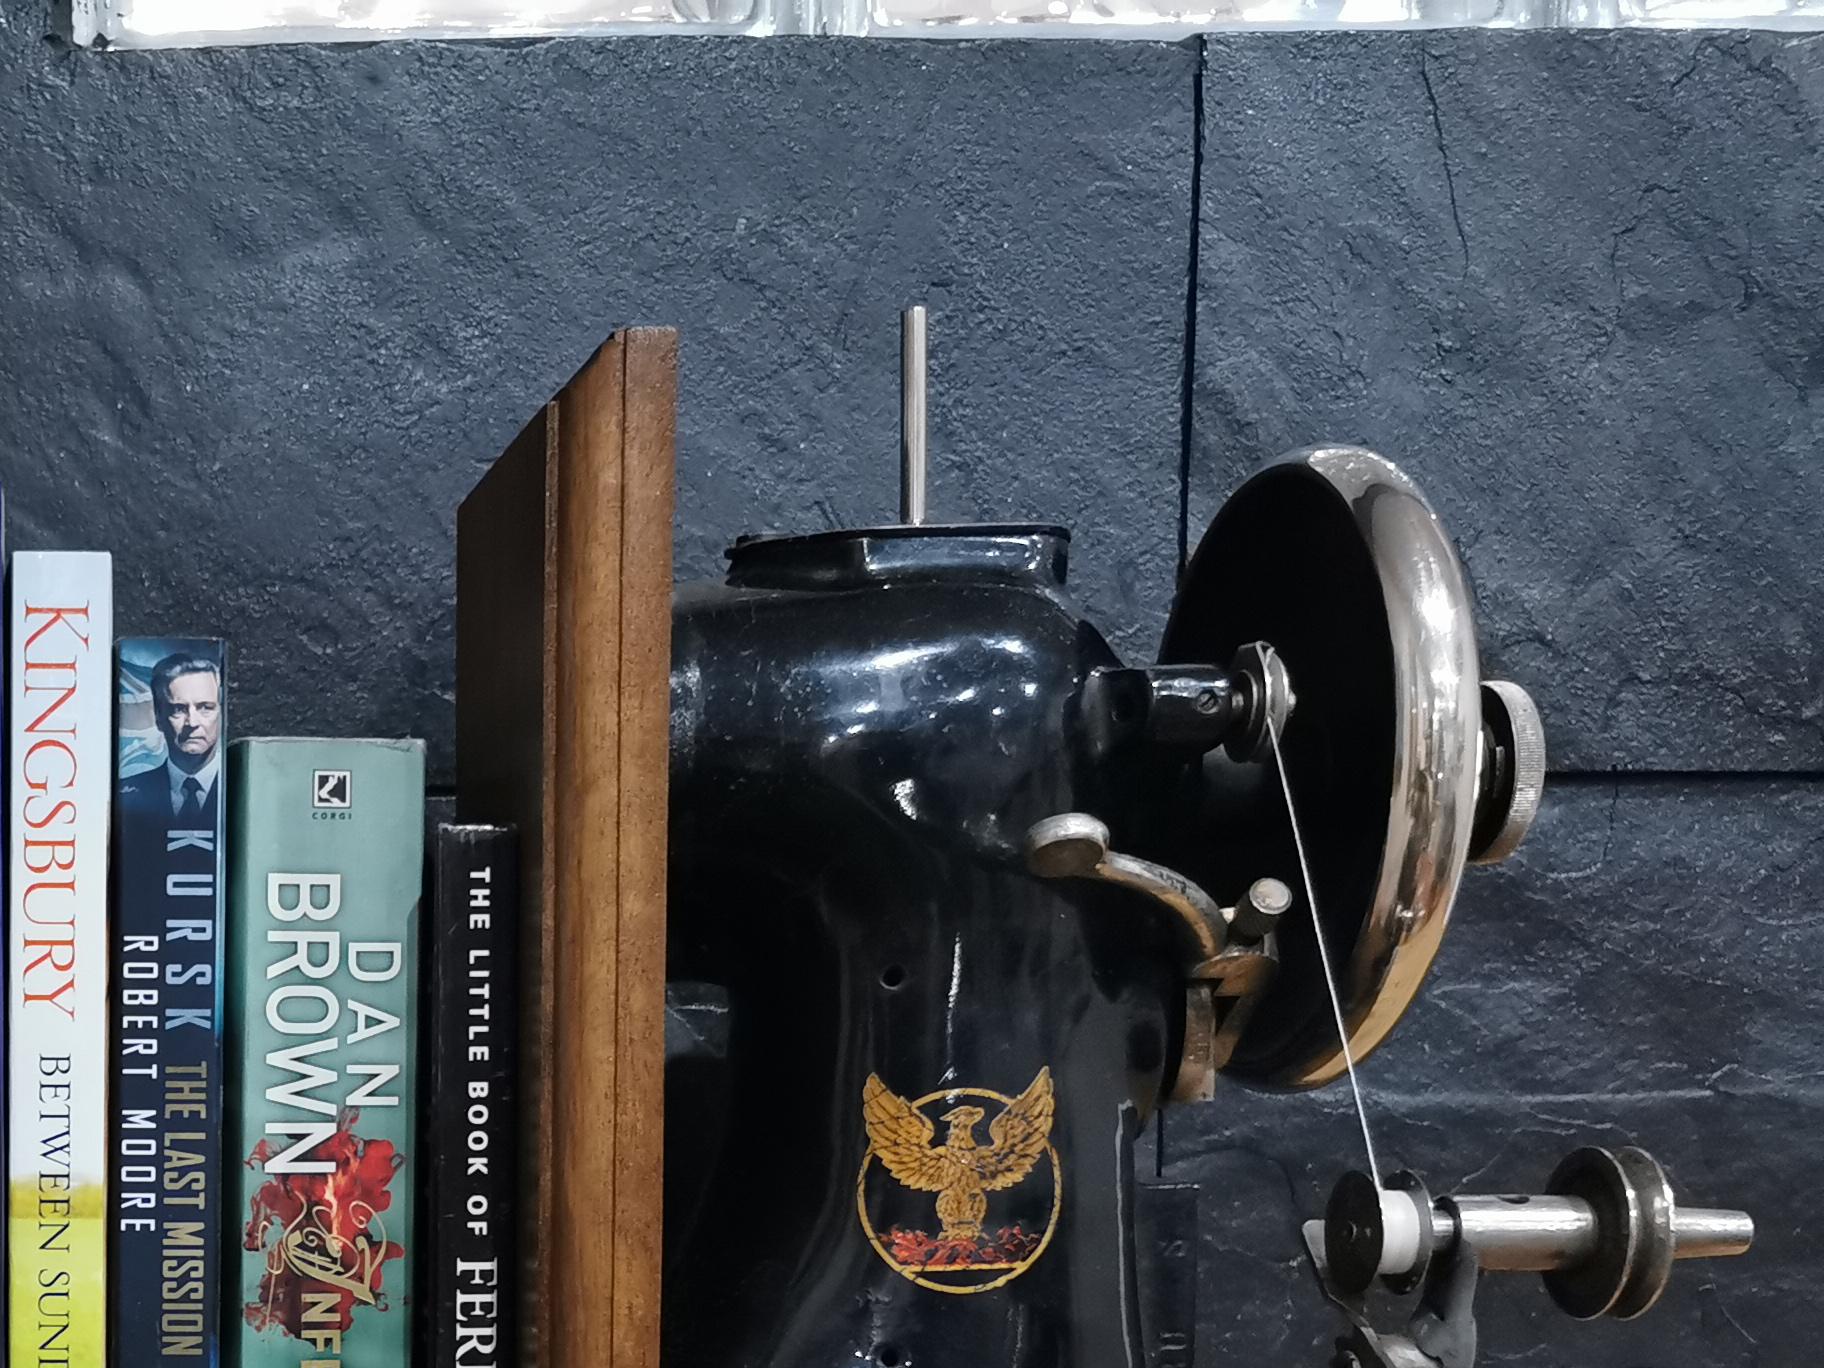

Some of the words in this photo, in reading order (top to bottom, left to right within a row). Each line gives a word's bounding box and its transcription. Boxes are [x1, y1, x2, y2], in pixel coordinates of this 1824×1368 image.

[23, 600, 89, 1020] KINGSBURY
[311, 811, 353, 821] CORGI
[165, 830, 214, 1033] KURSK
[470, 867, 490, 929] THE
[122, 936, 159, 1079] ROBERT
[264, 873, 341, 1174] BROWN
[346, 942, 402, 1106] DAN
[469, 950, 490, 1061] LITTLE
[165, 1061, 207, 1119] THE
[467, 1082, 488, 1175] BOOK
[38, 1053, 71, 1253] BETWEEN
[121, 1110, 156, 1231] MOORE
[163, 1133, 205, 1210] LAST
[467, 1195, 488, 1235] OF
[162, 1222, 205, 1354] MISSION
